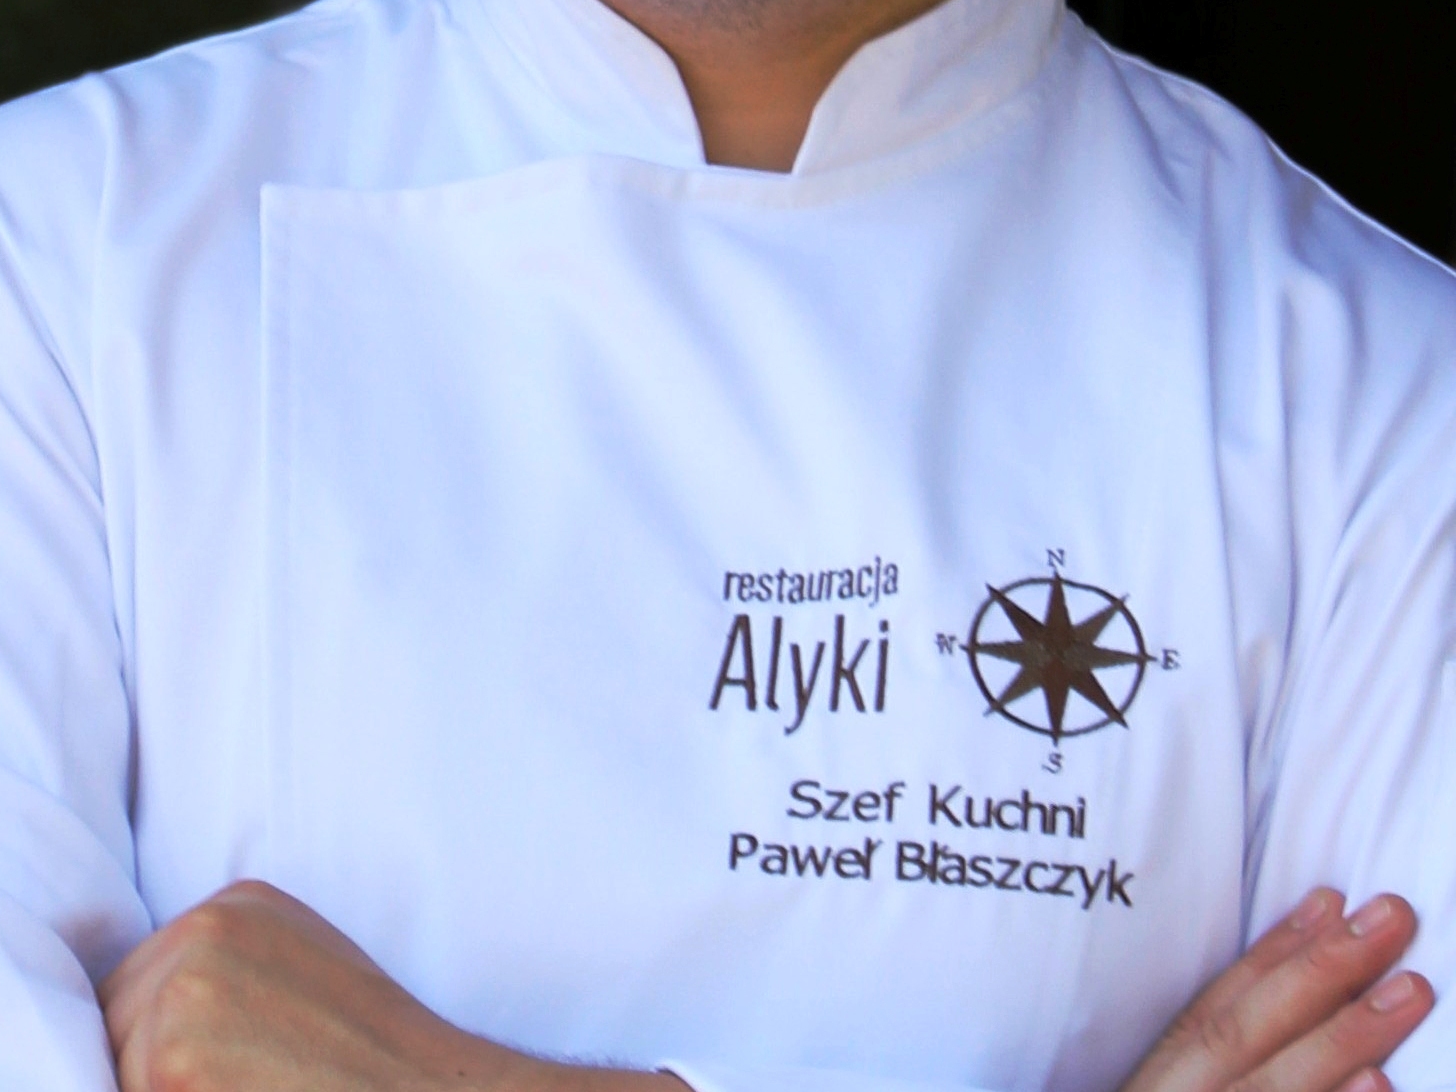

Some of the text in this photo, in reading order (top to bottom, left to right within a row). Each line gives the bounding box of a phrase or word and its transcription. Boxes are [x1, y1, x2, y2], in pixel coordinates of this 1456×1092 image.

[723, 556, 899, 608] restauracja
[1046, 548, 1066, 569] N
[709, 613, 890, 736] Alyki
[1160, 649, 1181, 671] E
[1042, 752, 1064, 775] S
[786, 780, 1087, 839] Szef Kuchni
[728, 832, 1135, 910] Paweł Błaszczyk
